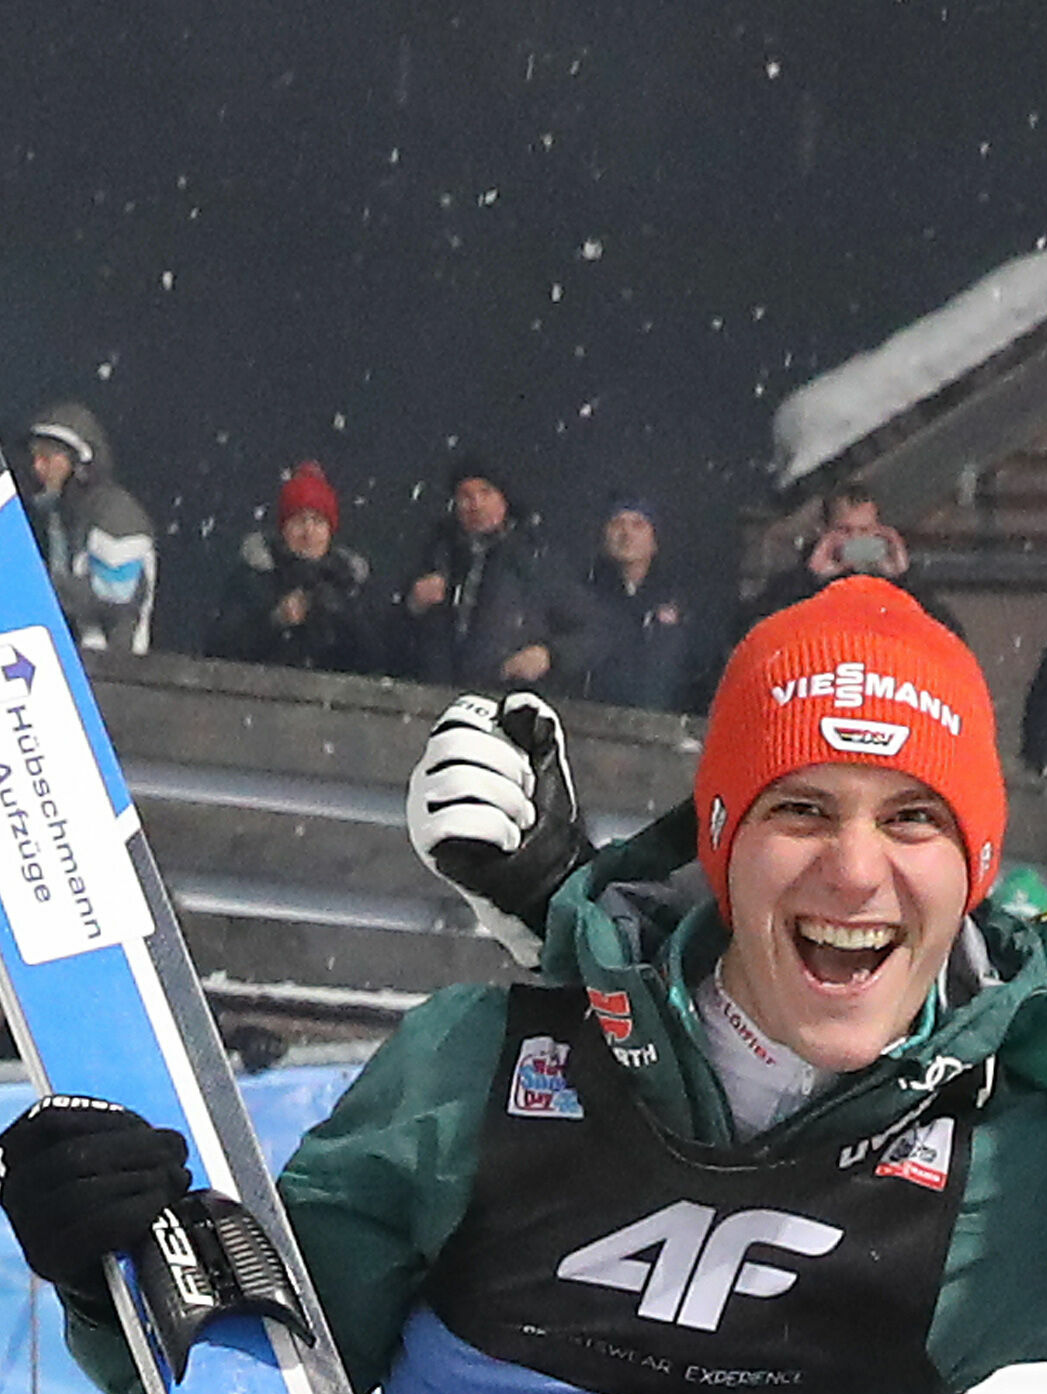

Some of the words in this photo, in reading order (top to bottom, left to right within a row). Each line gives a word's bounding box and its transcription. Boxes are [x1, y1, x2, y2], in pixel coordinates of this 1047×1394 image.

[772, 662, 961, 735] VIESSMANN
[7, 704, 101, 940] Hübschmann
[556, 1200, 845, 1332] 4F
